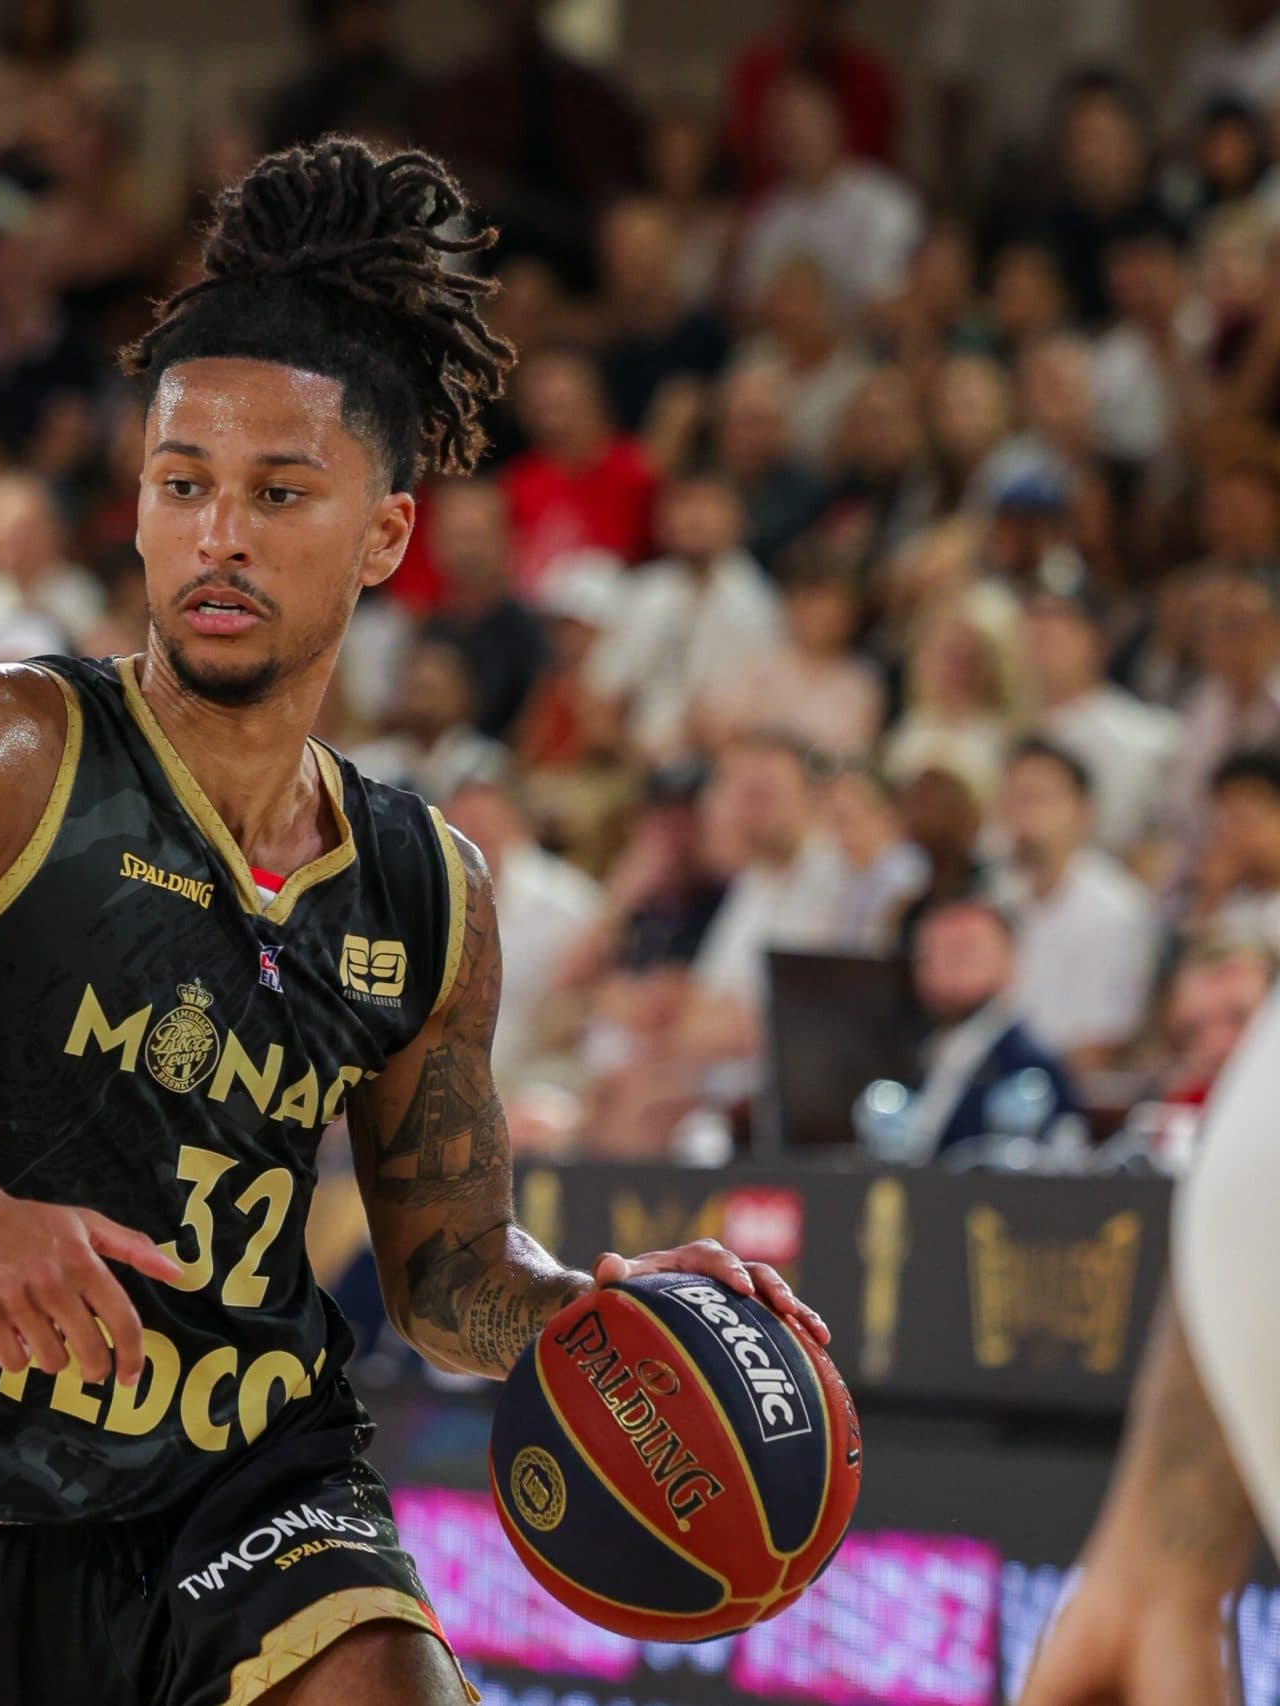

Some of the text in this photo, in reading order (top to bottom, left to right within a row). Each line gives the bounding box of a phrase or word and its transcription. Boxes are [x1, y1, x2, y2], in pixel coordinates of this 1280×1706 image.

[120, 853, 214, 909] SPALDING
[154, 1047, 205, 1068] Team
[156, 1071, 191, 1090] BASKET
[156, 1144, 294, 1307] 32
[671, 1285, 796, 1427] Betclic
[554, 1310, 726, 1522] SPALDING
[274, 1537, 378, 1571] SPALDING
